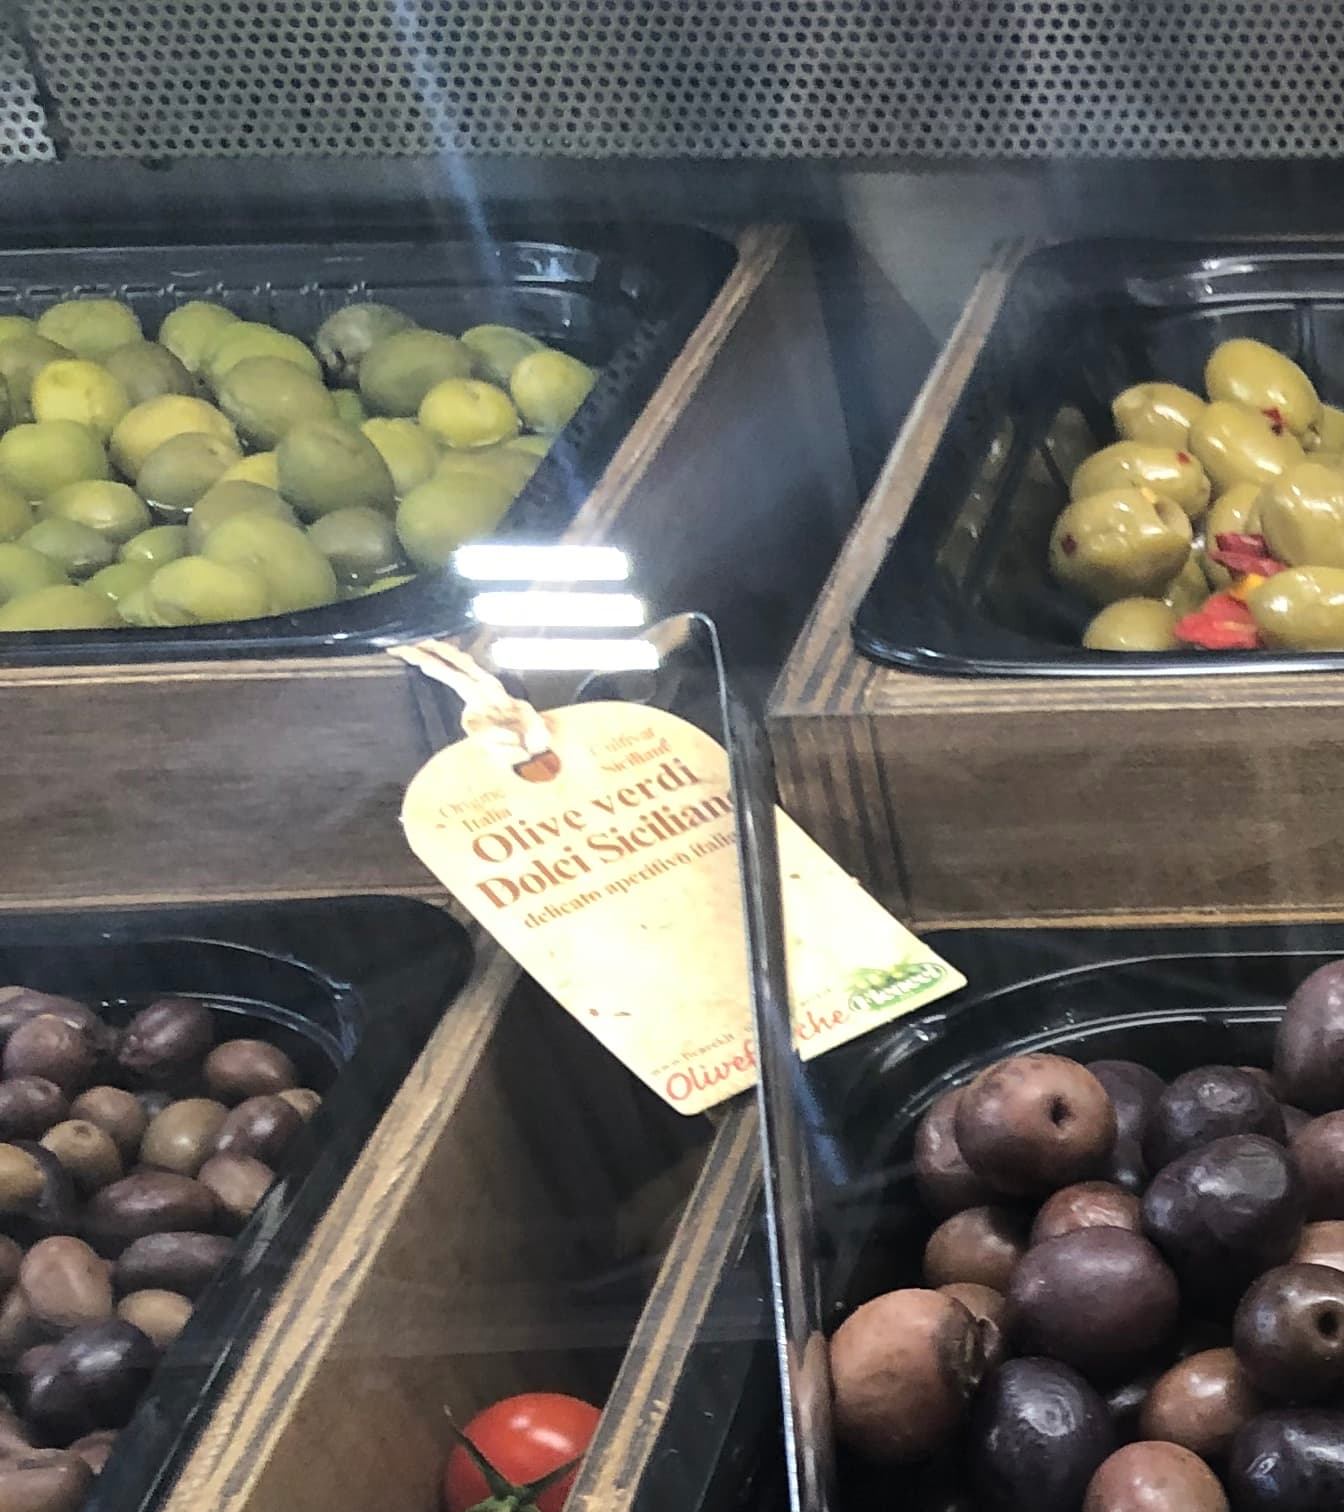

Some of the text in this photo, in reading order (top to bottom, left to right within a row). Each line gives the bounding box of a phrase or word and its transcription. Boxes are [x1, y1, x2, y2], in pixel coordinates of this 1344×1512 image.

[471, 757, 701, 864] Olive verdi
[475, 789, 735, 909] Dolci Sicilian
[524, 889, 603, 929] delicato
[604, 852, 692, 897] aperitivo
